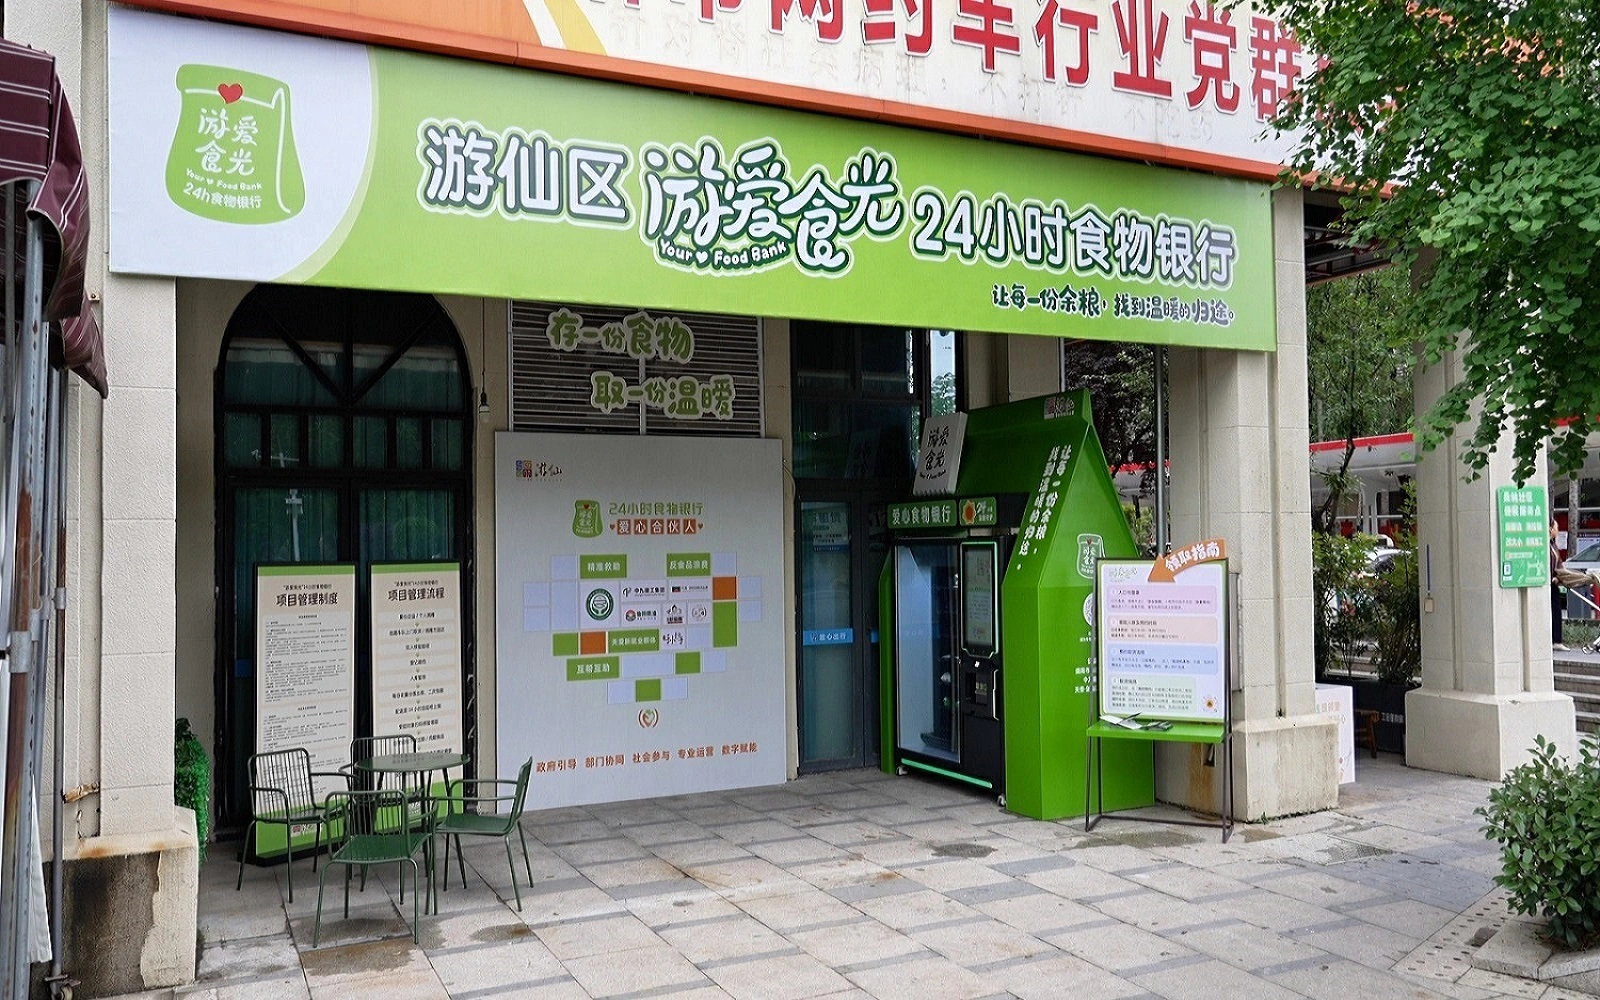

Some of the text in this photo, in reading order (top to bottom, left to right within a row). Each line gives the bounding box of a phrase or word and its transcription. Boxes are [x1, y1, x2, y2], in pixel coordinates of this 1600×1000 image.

[197, 107, 259, 146] 游爱
[195, 140, 255, 176] 食光
[185, 168, 263, 191] Your Food Bank
[424, 124, 630, 220] 游仙区
[182, 182, 263, 210] 24h食物银行
[659, 239, 788, 266] Your Food Bank
[912, 193, 1234, 286] 24小时食物银行
[549, 311, 692, 361] 存一份食物
[593, 373, 734, 417] 取一份温暖
[609, 501, 705, 516] 24小时食物银行
[892, 504, 951, 526] 爱心食物银行
[617, 518, 697, 536] 爱心合伙人
[587, 561, 621, 572] 精准救助
[669, 560, 709, 571] 反食品浪费
[1164, 541, 1221, 572] 领取指南
[276, 592, 339, 607] 项目管理制度
[387, 587, 445, 601] 项目管理流程
[536, 741, 758, 773] 政府引导 部门协同 社会参与 专业运营 数字赋能
